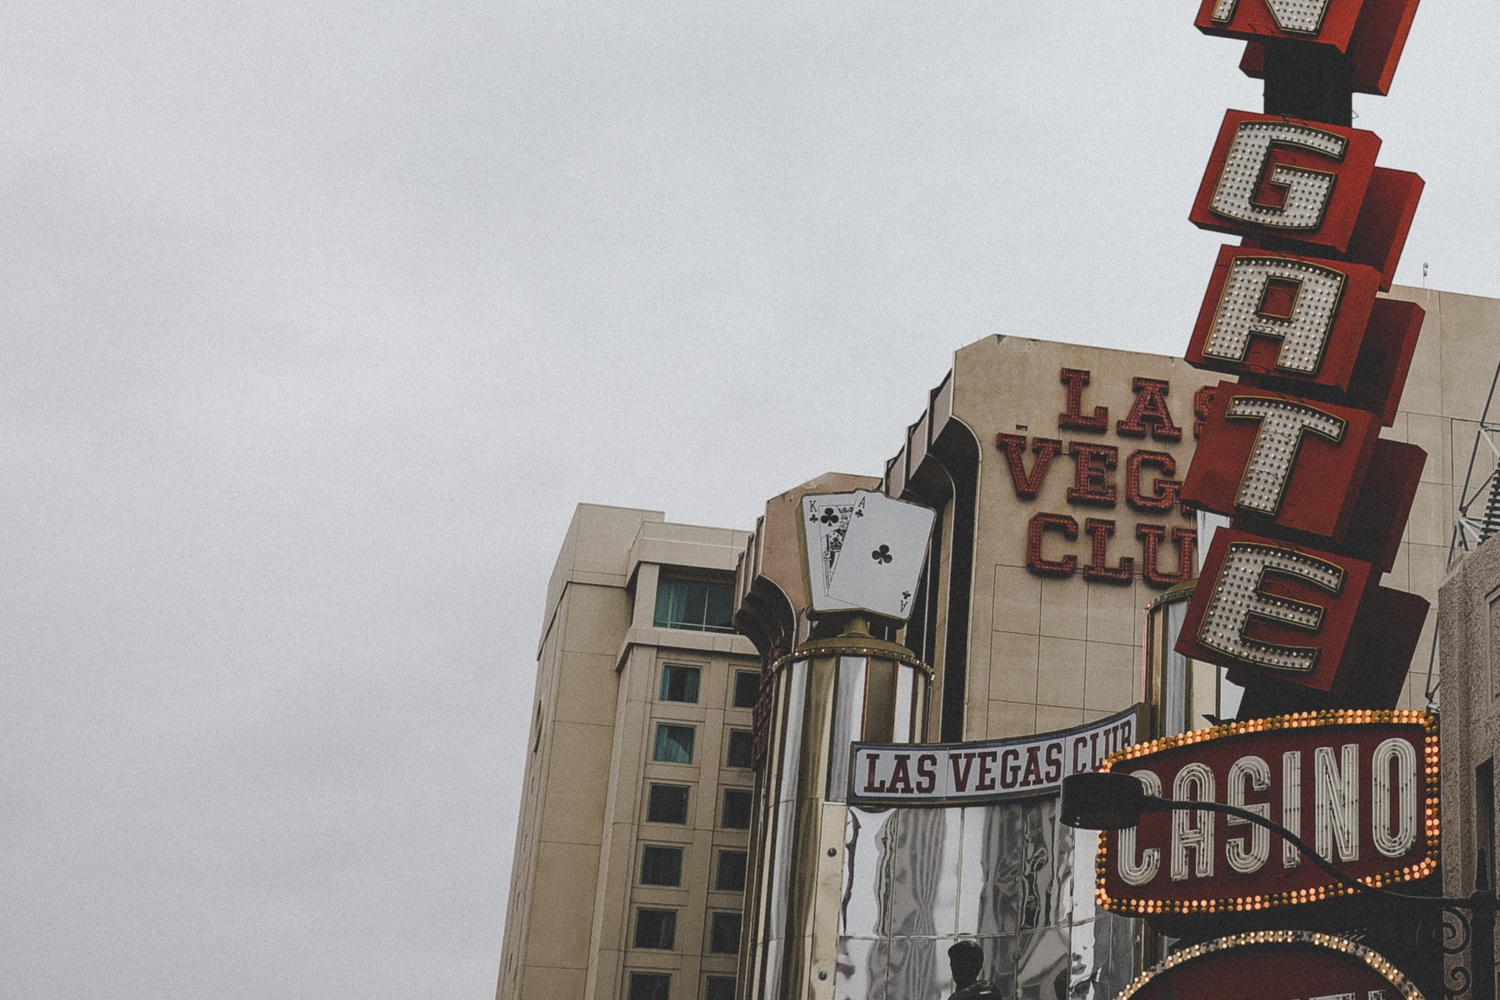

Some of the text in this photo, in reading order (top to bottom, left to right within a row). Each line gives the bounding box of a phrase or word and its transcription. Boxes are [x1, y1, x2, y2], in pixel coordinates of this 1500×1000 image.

[1196, 120, 1349, 673] GATE
[809, 500, 818, 513] K
[857, 496, 866, 509] A
[996, 432, 1196, 516] VEG
[1026, 511, 1197, 587] CLU
[863, 753, 938, 794] LAS
[949, 742, 1062, 793] VEGAS
[1117, 737, 1418, 887] CASINO
